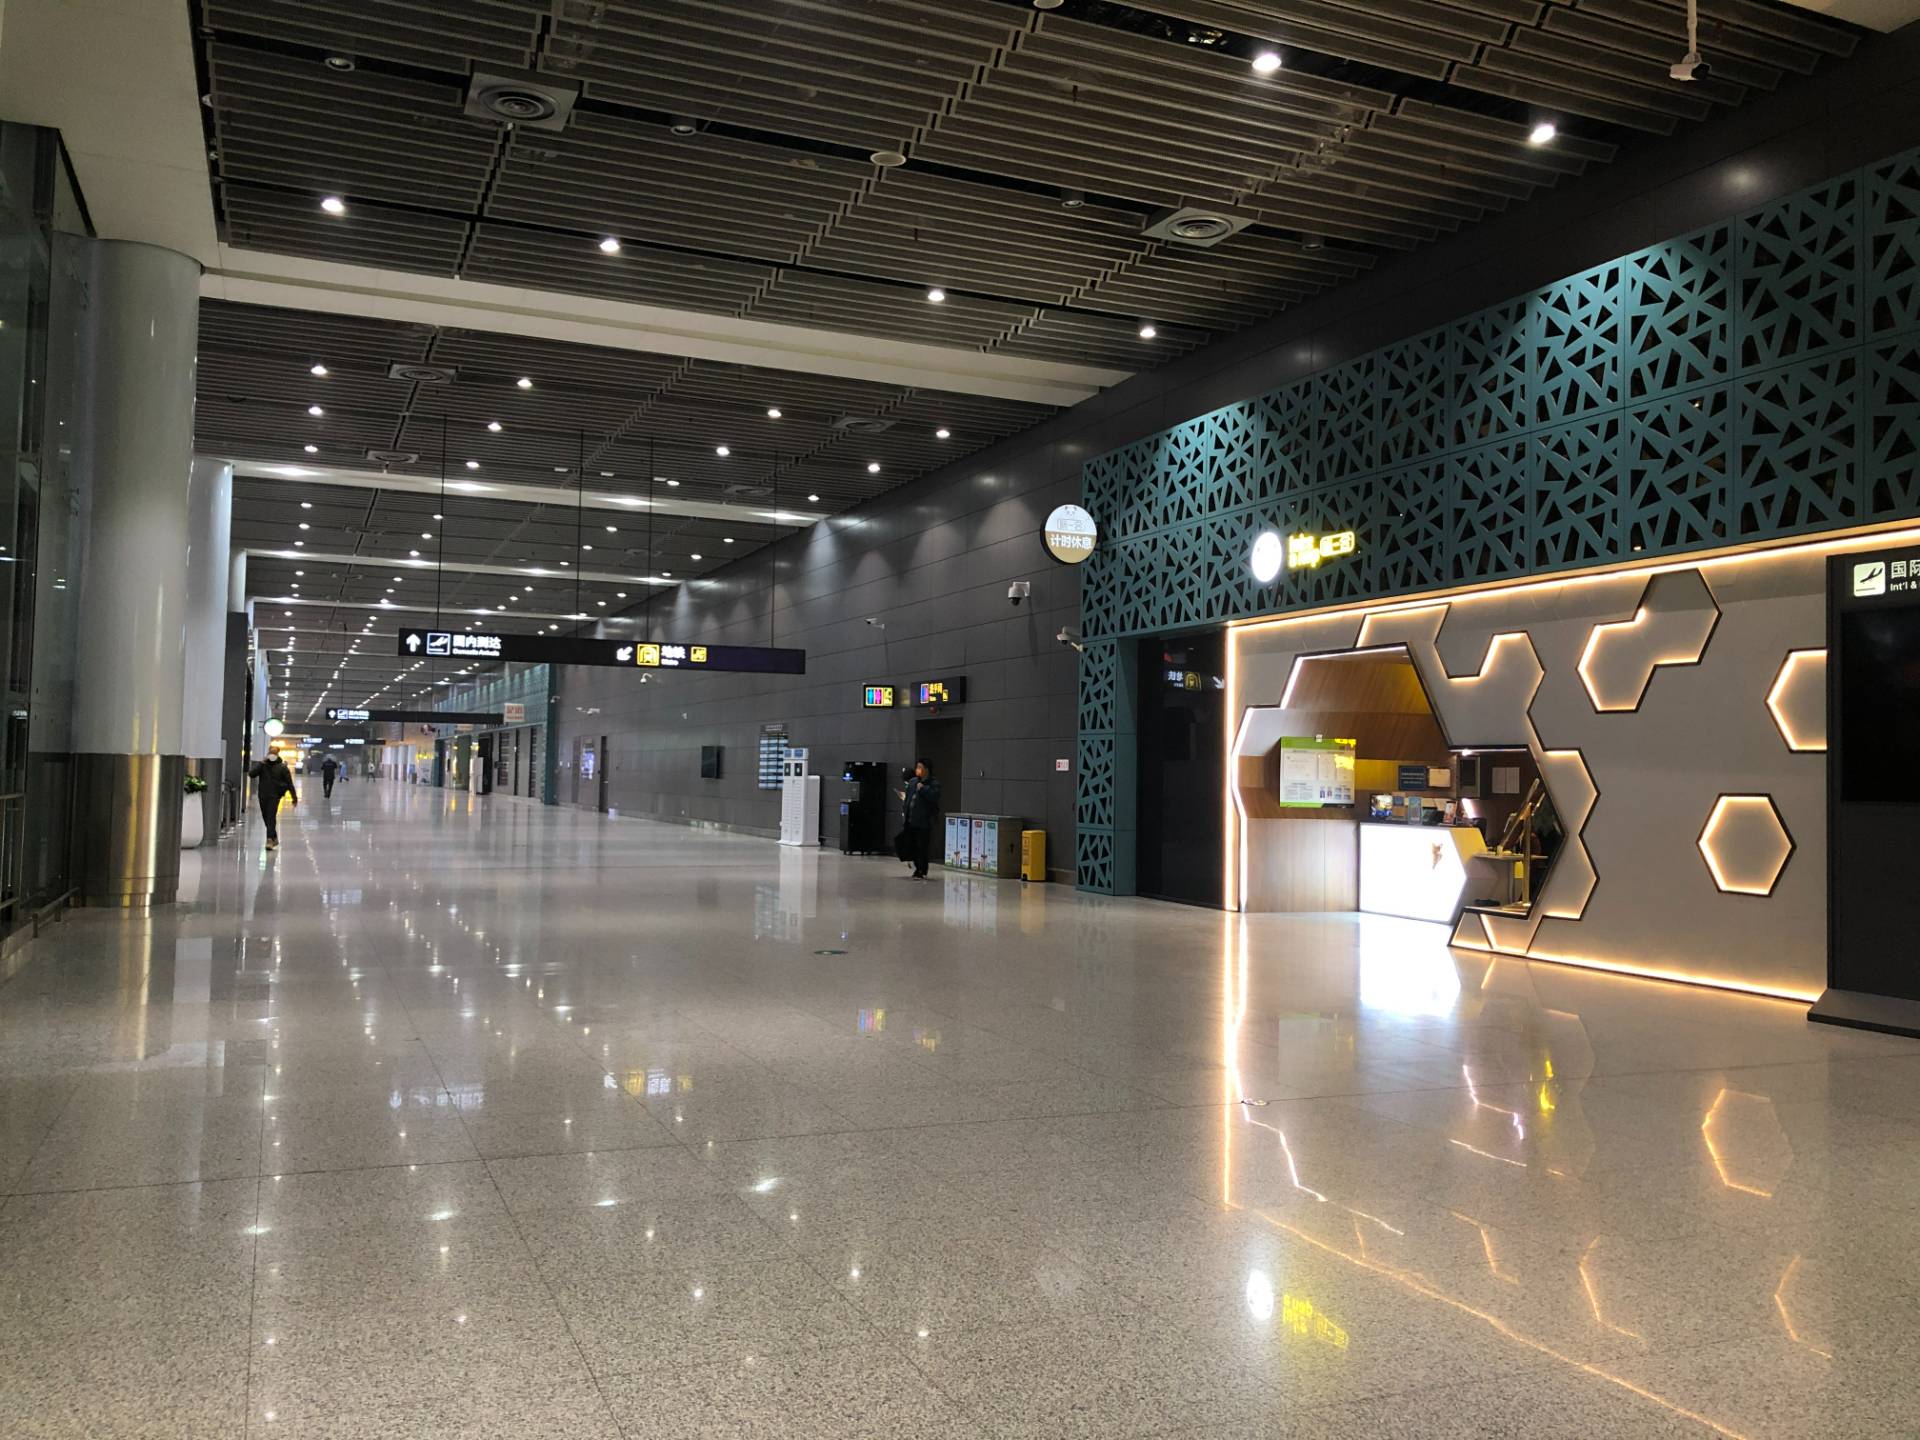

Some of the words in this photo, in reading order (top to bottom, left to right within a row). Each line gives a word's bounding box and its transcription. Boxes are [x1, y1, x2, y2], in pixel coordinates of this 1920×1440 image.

[1051, 533, 1092, 550] 计时休息
[1890, 581, 1908, 592] Int'l
